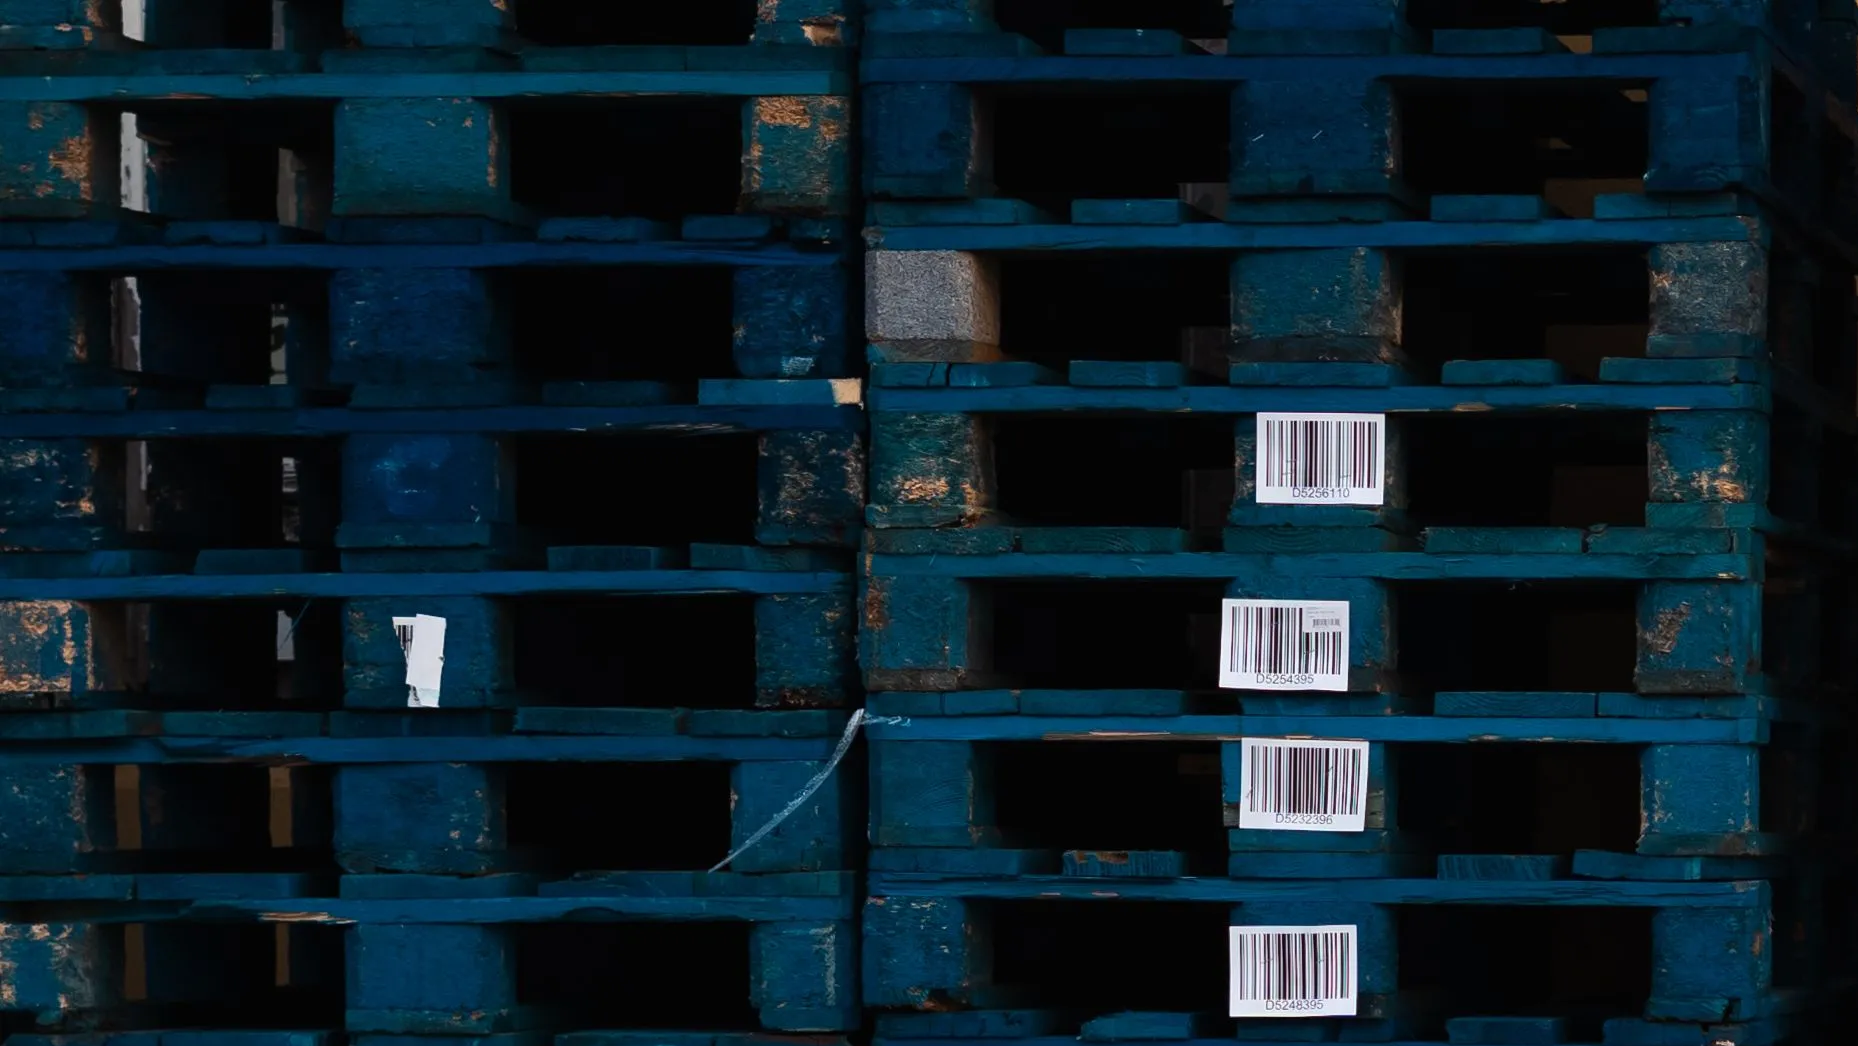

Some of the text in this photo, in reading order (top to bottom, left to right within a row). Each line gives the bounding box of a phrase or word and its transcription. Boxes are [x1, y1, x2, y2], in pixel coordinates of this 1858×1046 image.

[1292, 488, 1350, 498] D5256110
[1256, 673, 1314, 685] D5254395
[1275, 813, 1333, 825] D5232396
[1265, 999, 1324, 1011] D5248395
